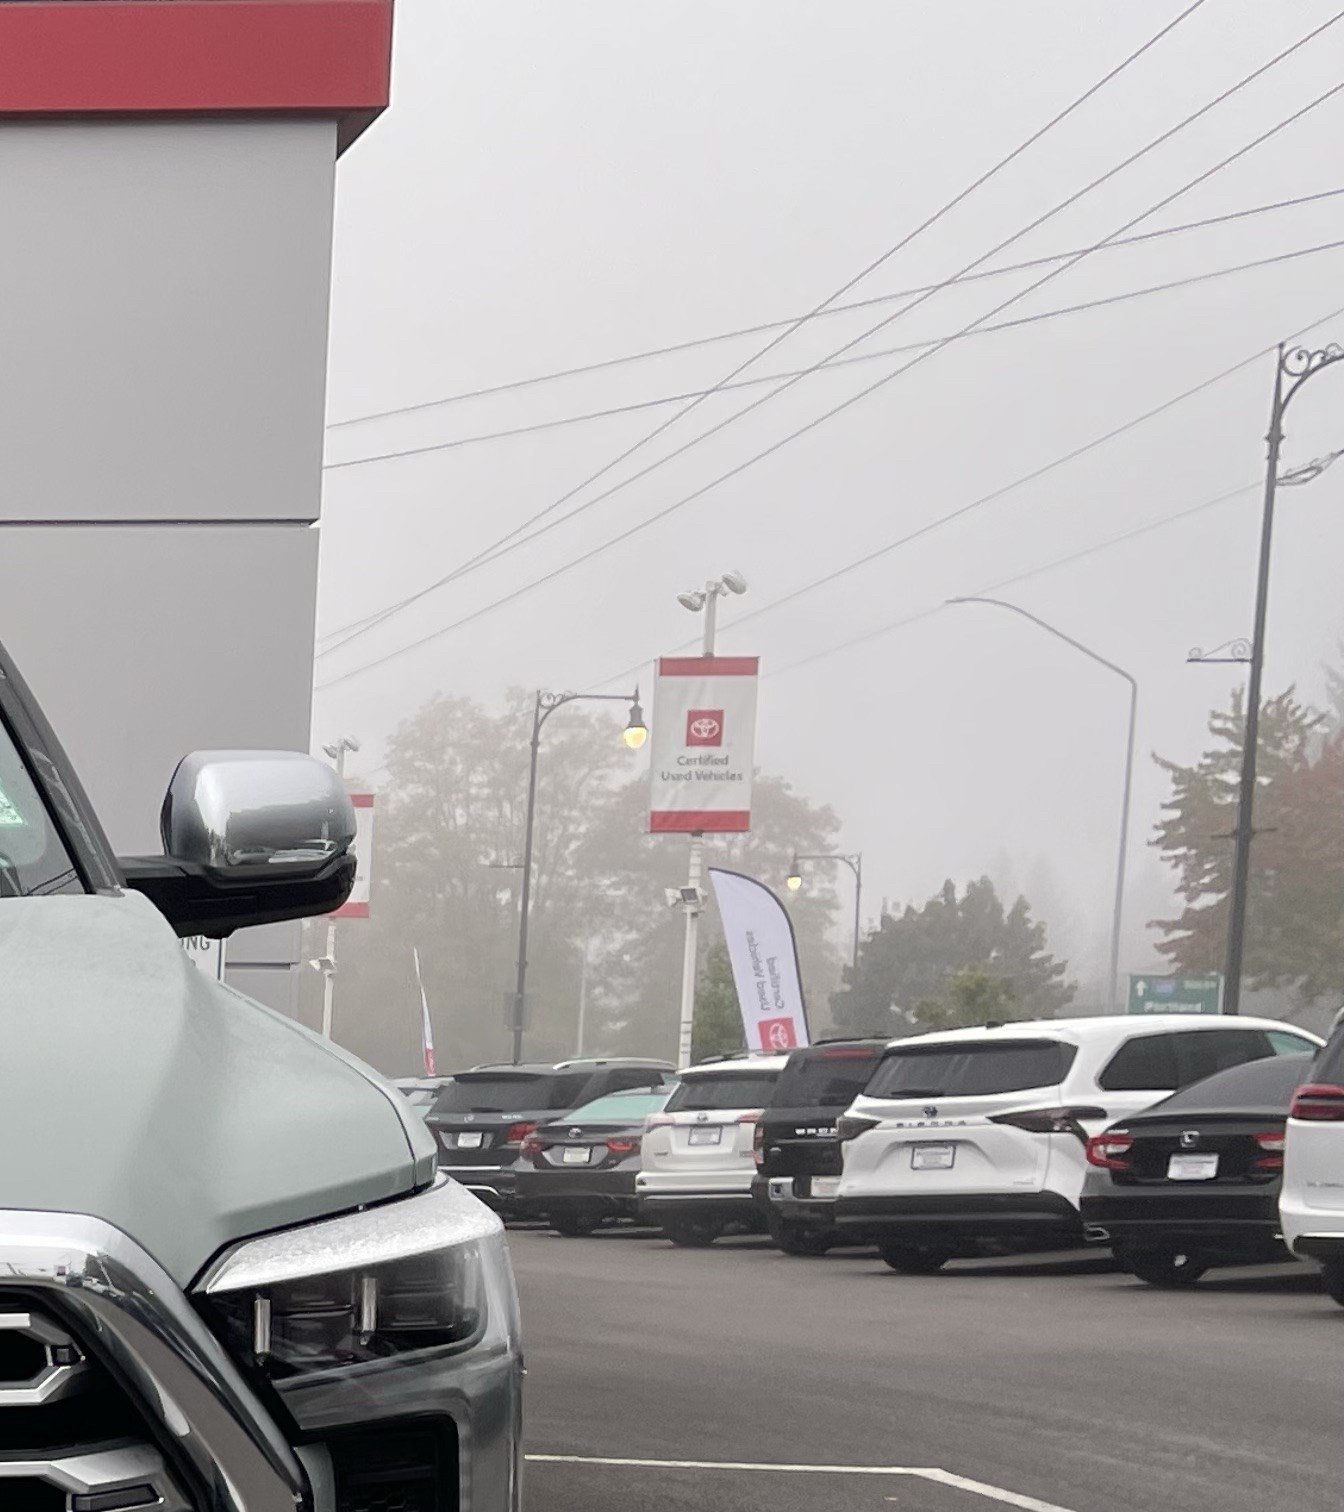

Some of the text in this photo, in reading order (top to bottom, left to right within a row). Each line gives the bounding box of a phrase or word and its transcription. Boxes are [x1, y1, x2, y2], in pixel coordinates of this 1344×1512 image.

[676, 755, 729, 767] Certified
[661, 770, 743, 782] Used Vehicles
